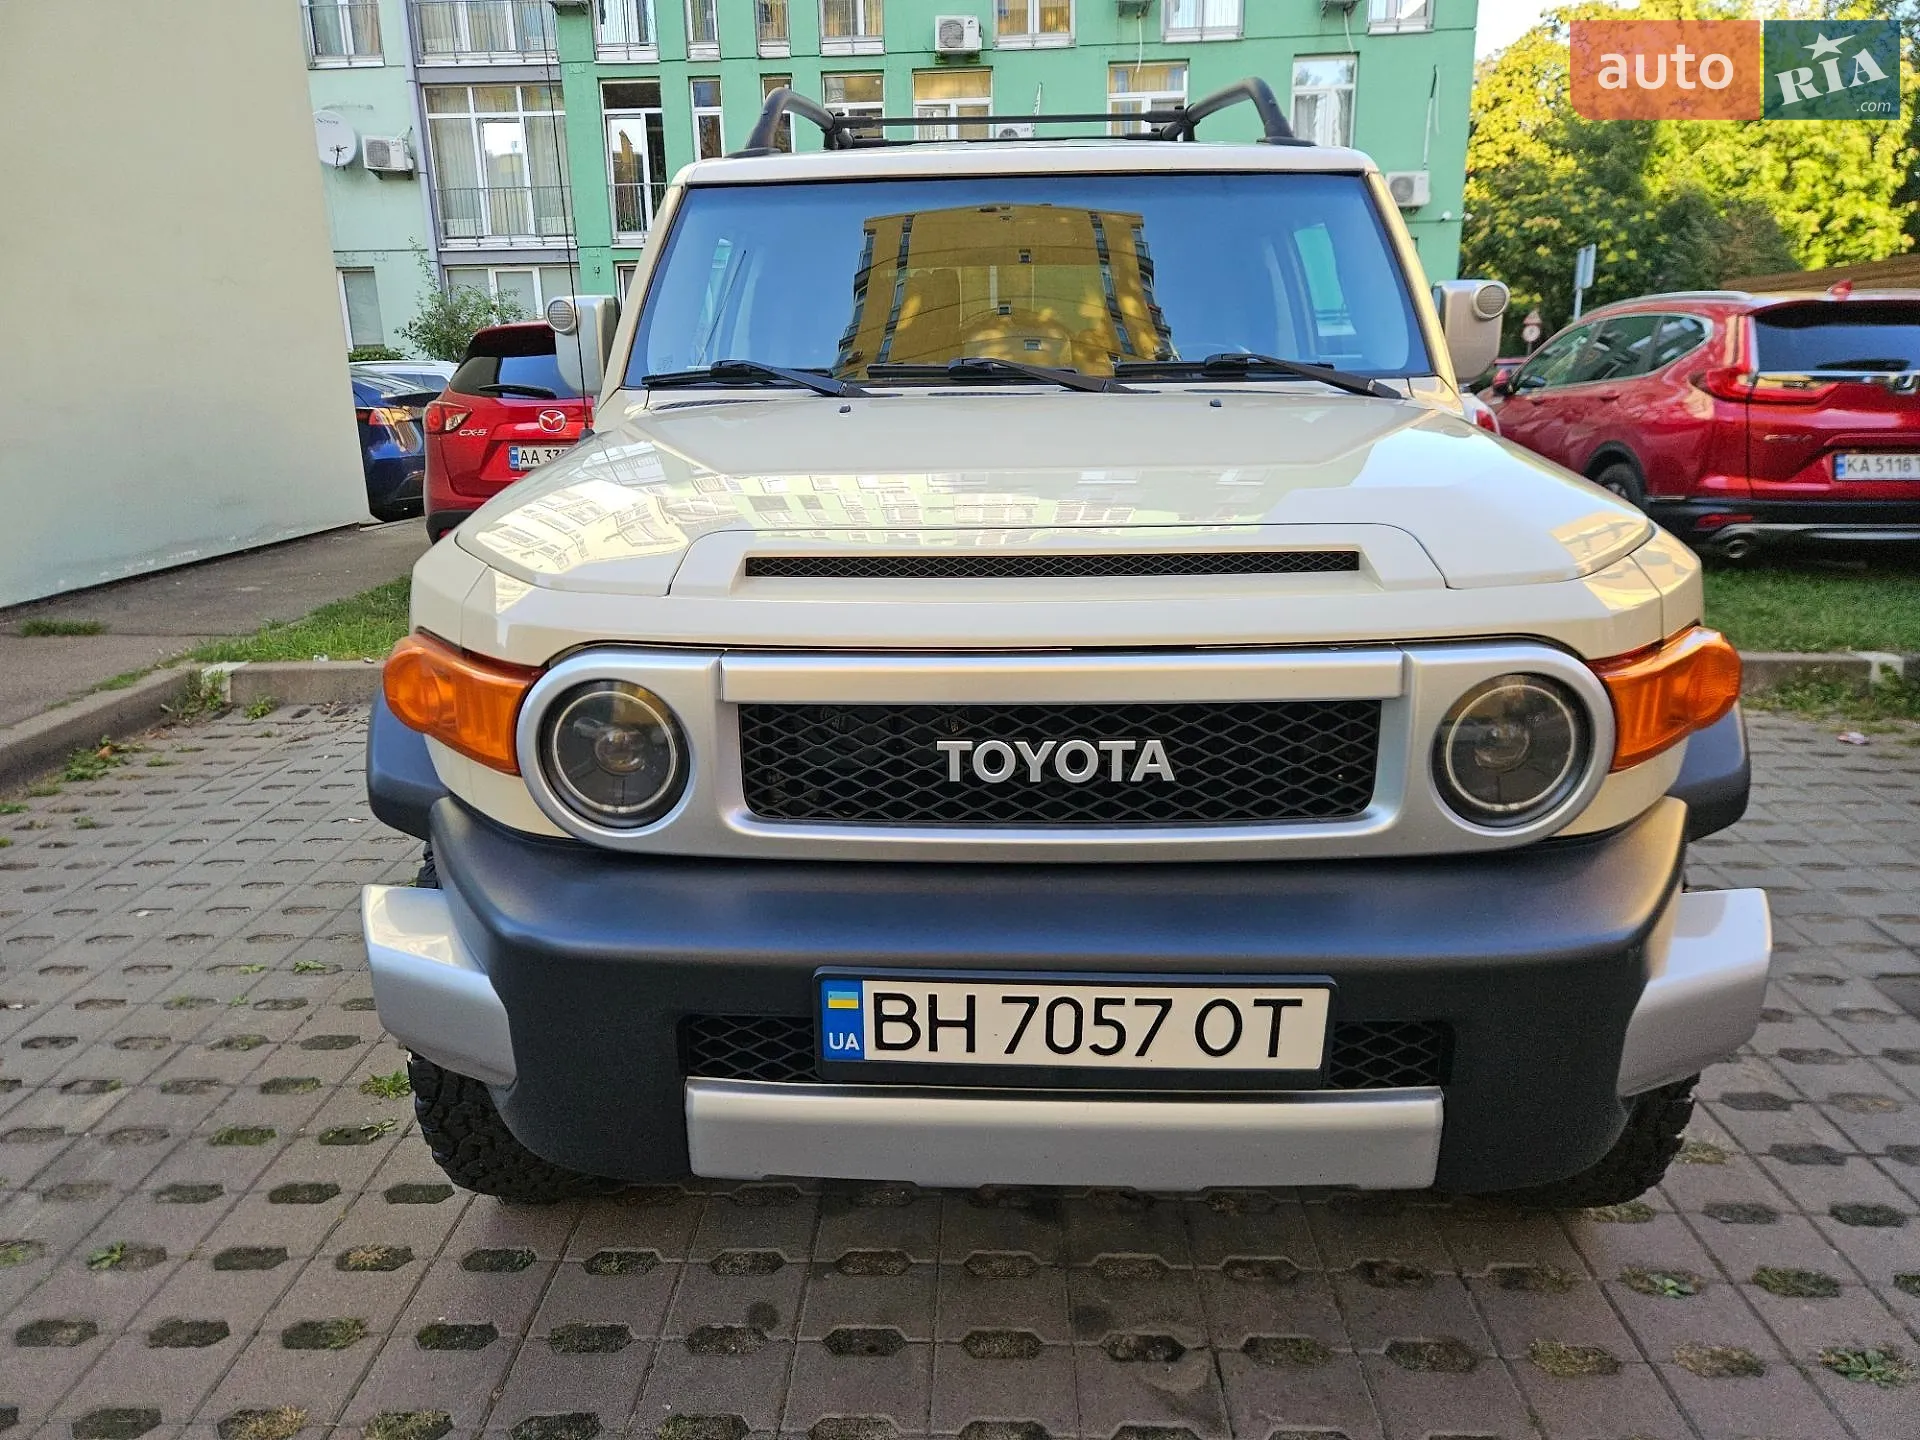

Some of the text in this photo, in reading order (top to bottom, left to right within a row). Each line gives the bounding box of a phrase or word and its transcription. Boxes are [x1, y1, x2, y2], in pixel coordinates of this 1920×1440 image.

[459, 428, 488, 437] CX-5
[519, 449, 541, 465] AA
[1847, 457, 1870, 473] KA
[936, 739, 1176, 784] TOYOTA
[872, 992, 1304, 1058] BH 7057 OT
[829, 1031, 861, 1051] UA
